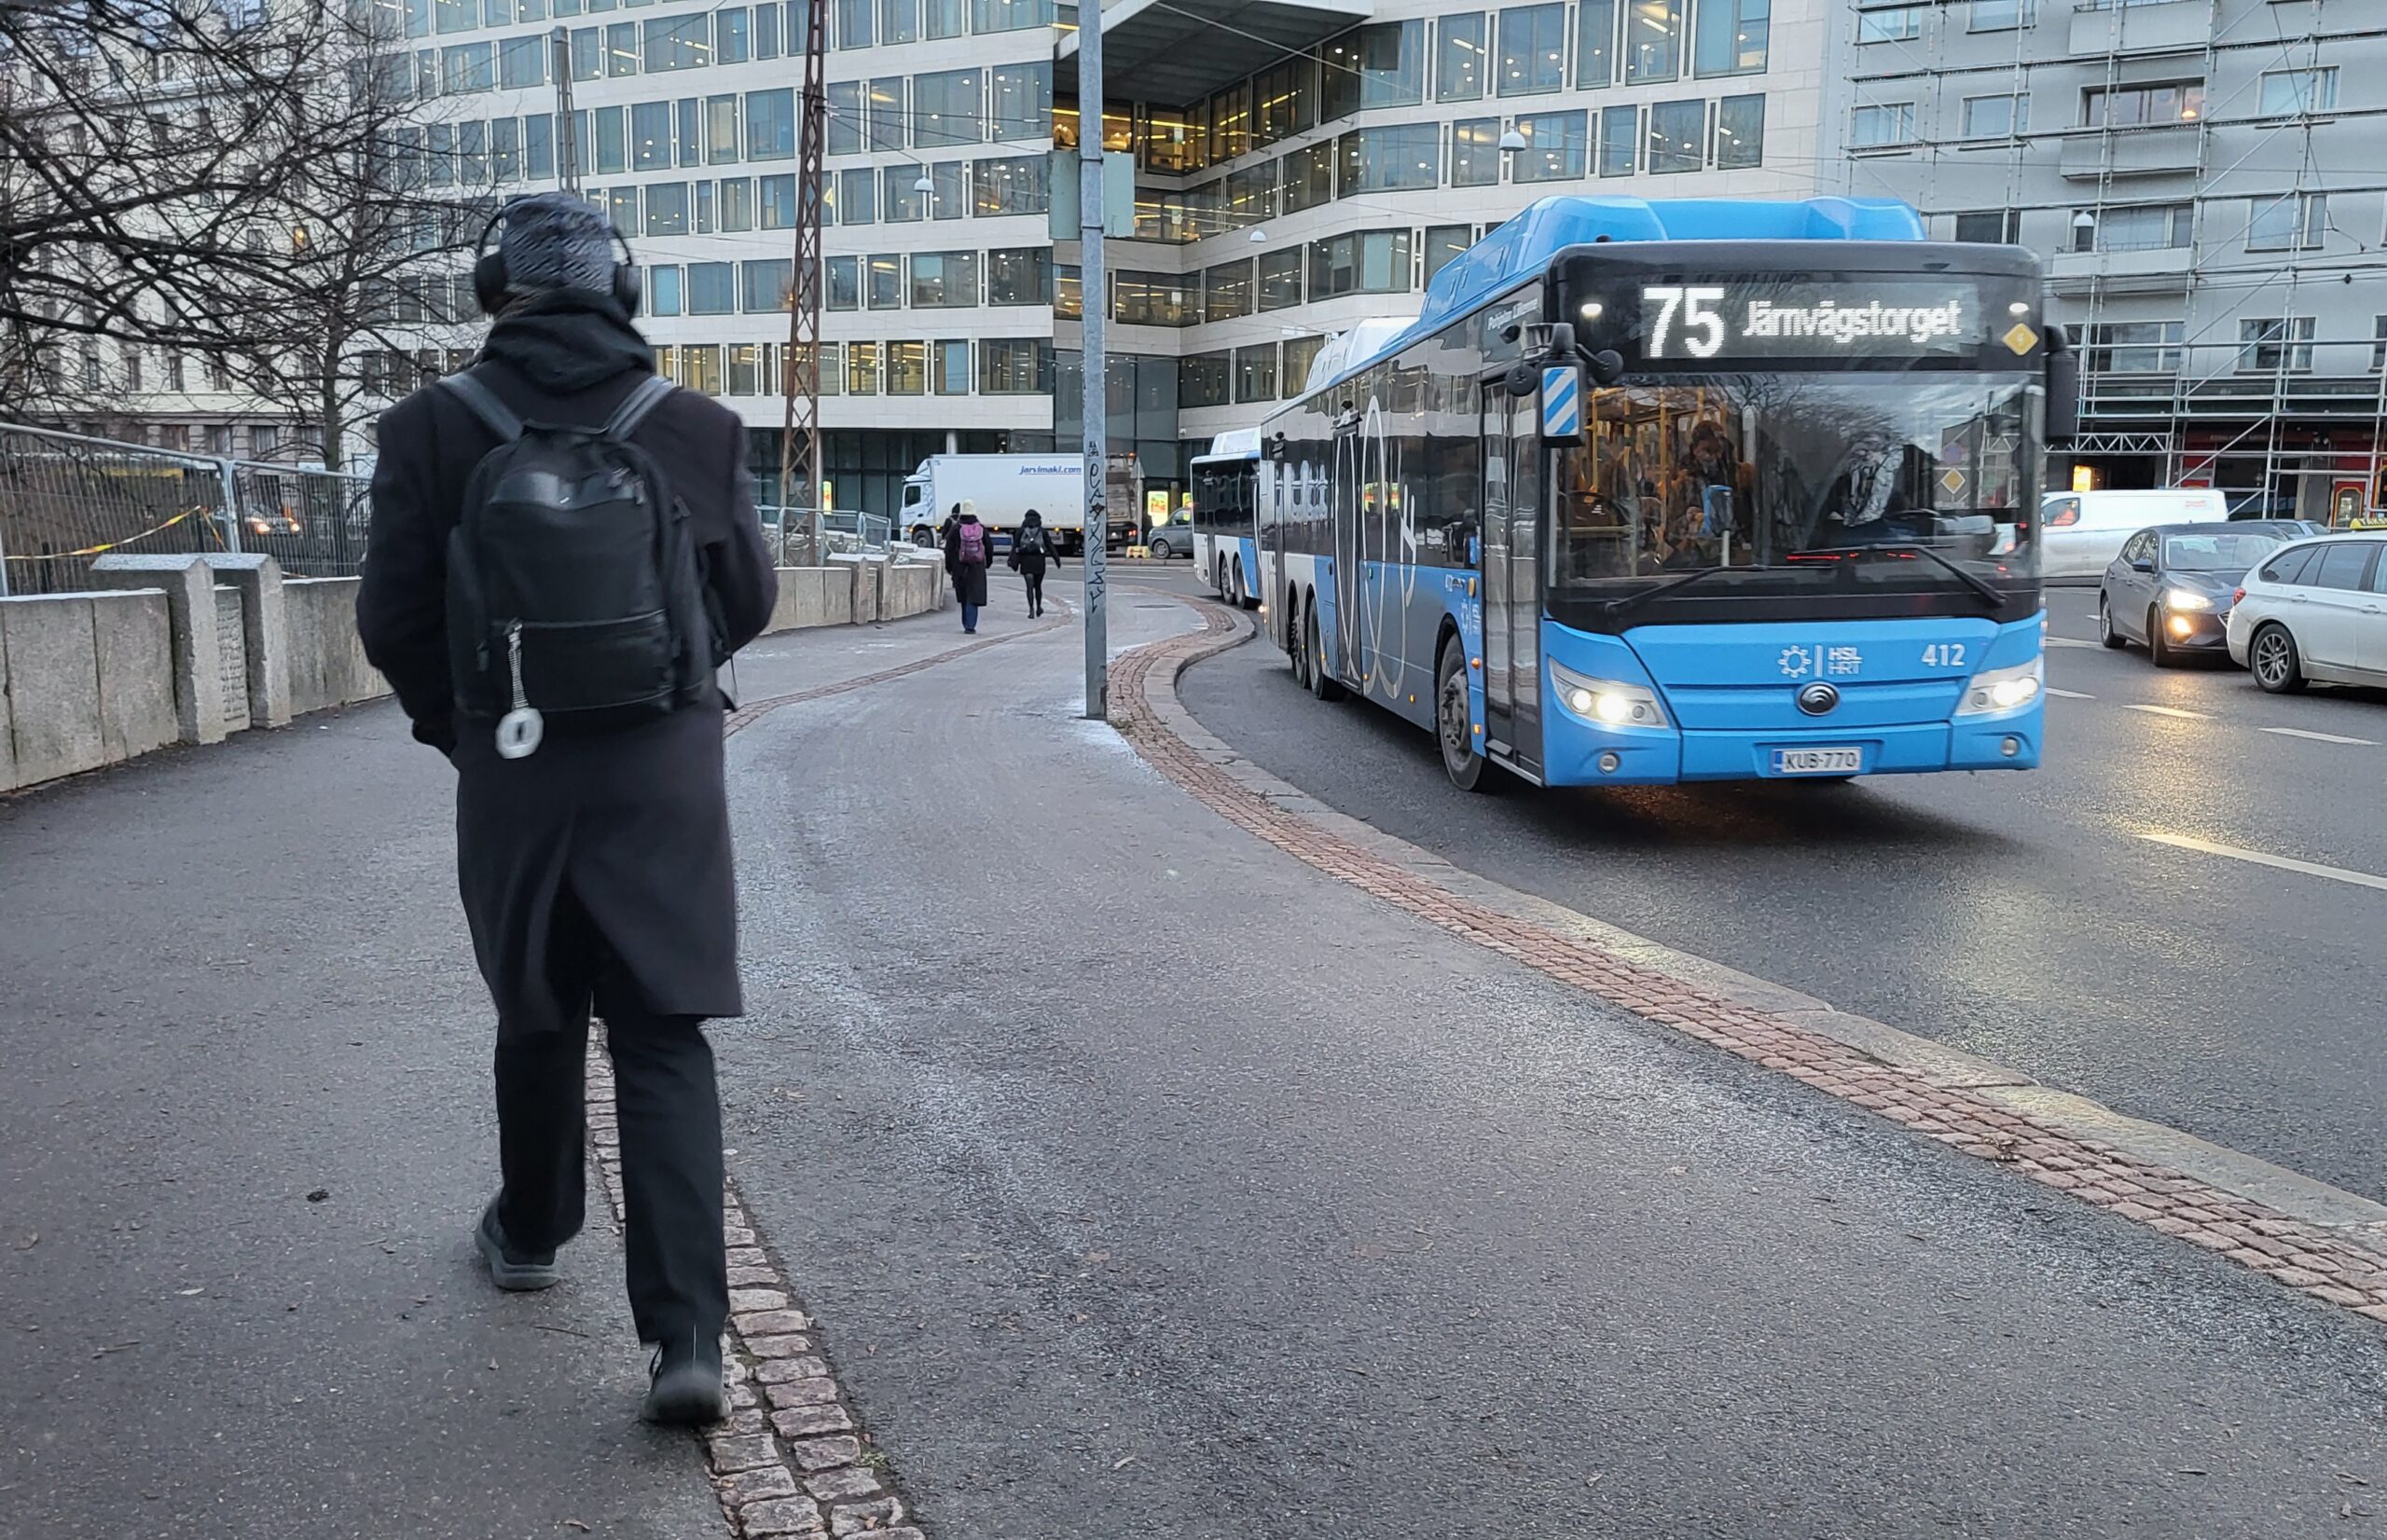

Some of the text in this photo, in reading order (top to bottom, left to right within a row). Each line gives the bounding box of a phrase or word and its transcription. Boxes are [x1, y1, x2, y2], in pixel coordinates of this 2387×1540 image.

[1643, 287, 1963, 358] 75 Järnvägstorget
[1828, 647, 1863, 661] HSL
[1921, 643, 1966, 667] 412
[1828, 660, 1863, 675] HRT
[1785, 751, 1857, 770] KUB-770
